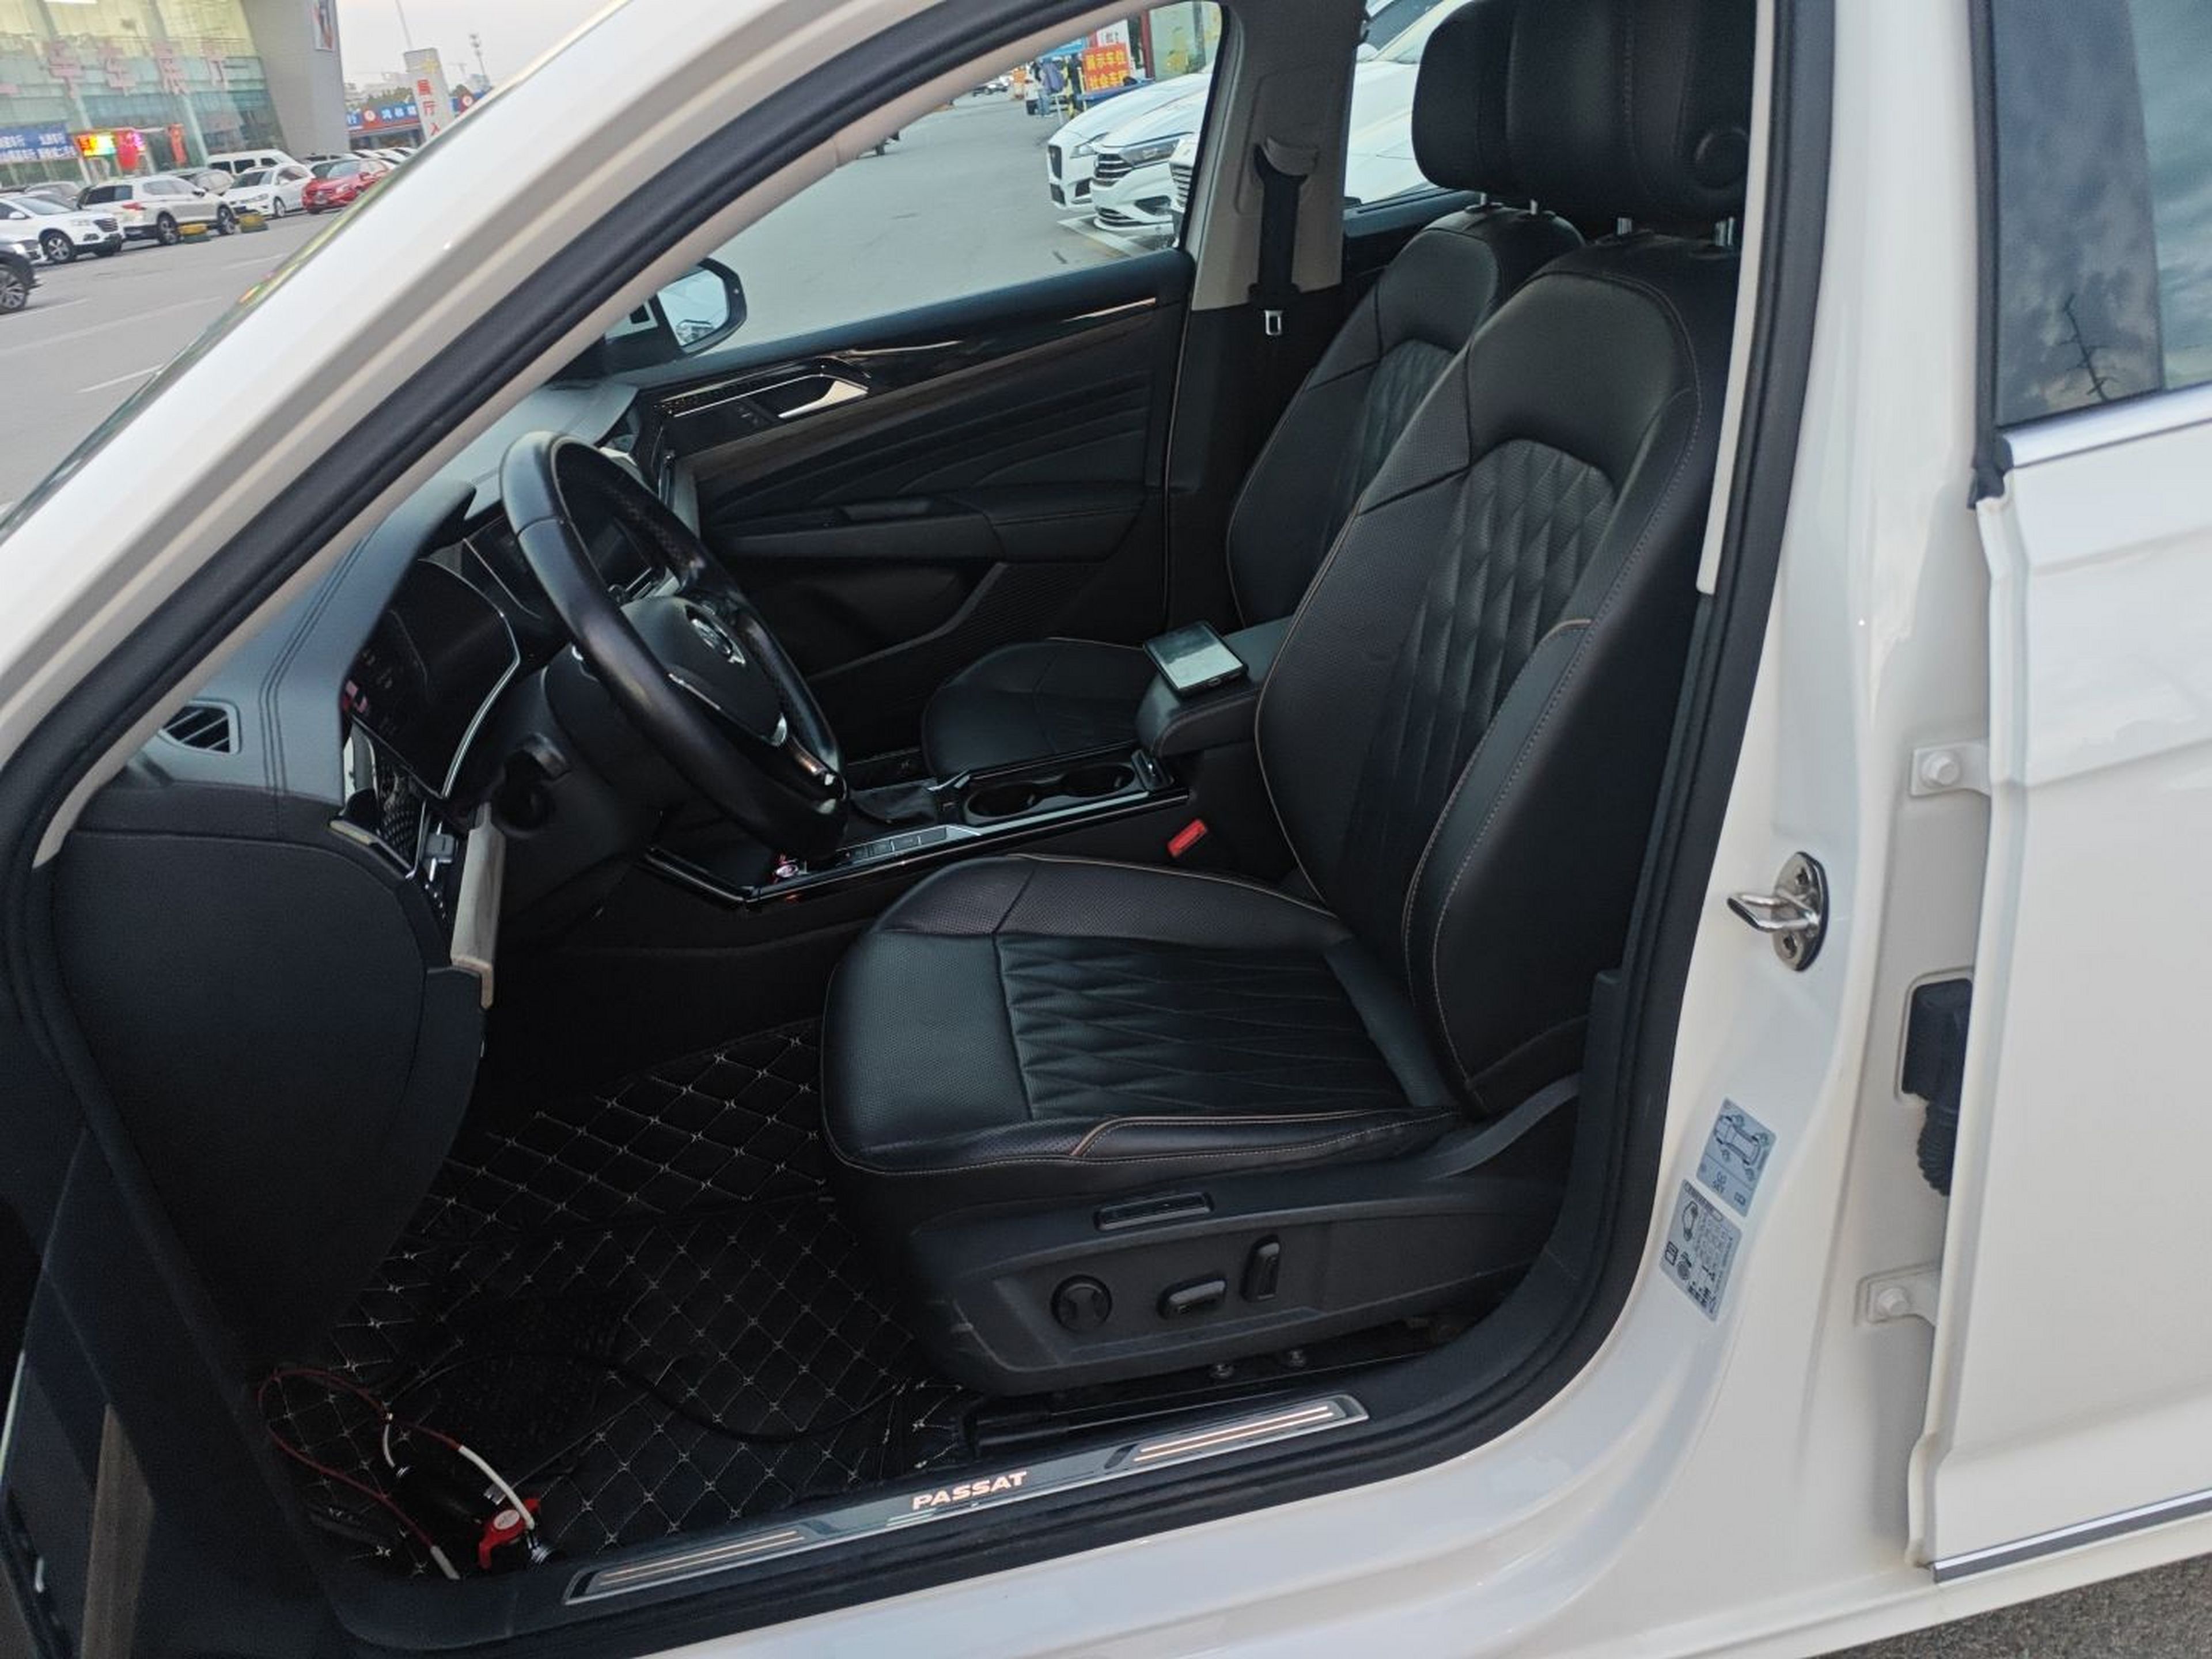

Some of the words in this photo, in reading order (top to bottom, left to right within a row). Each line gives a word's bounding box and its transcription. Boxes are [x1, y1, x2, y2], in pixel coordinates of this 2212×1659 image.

[0, 39, 233, 99] 手车展厅
[912, 1471, 1027, 1510] PASSAT
